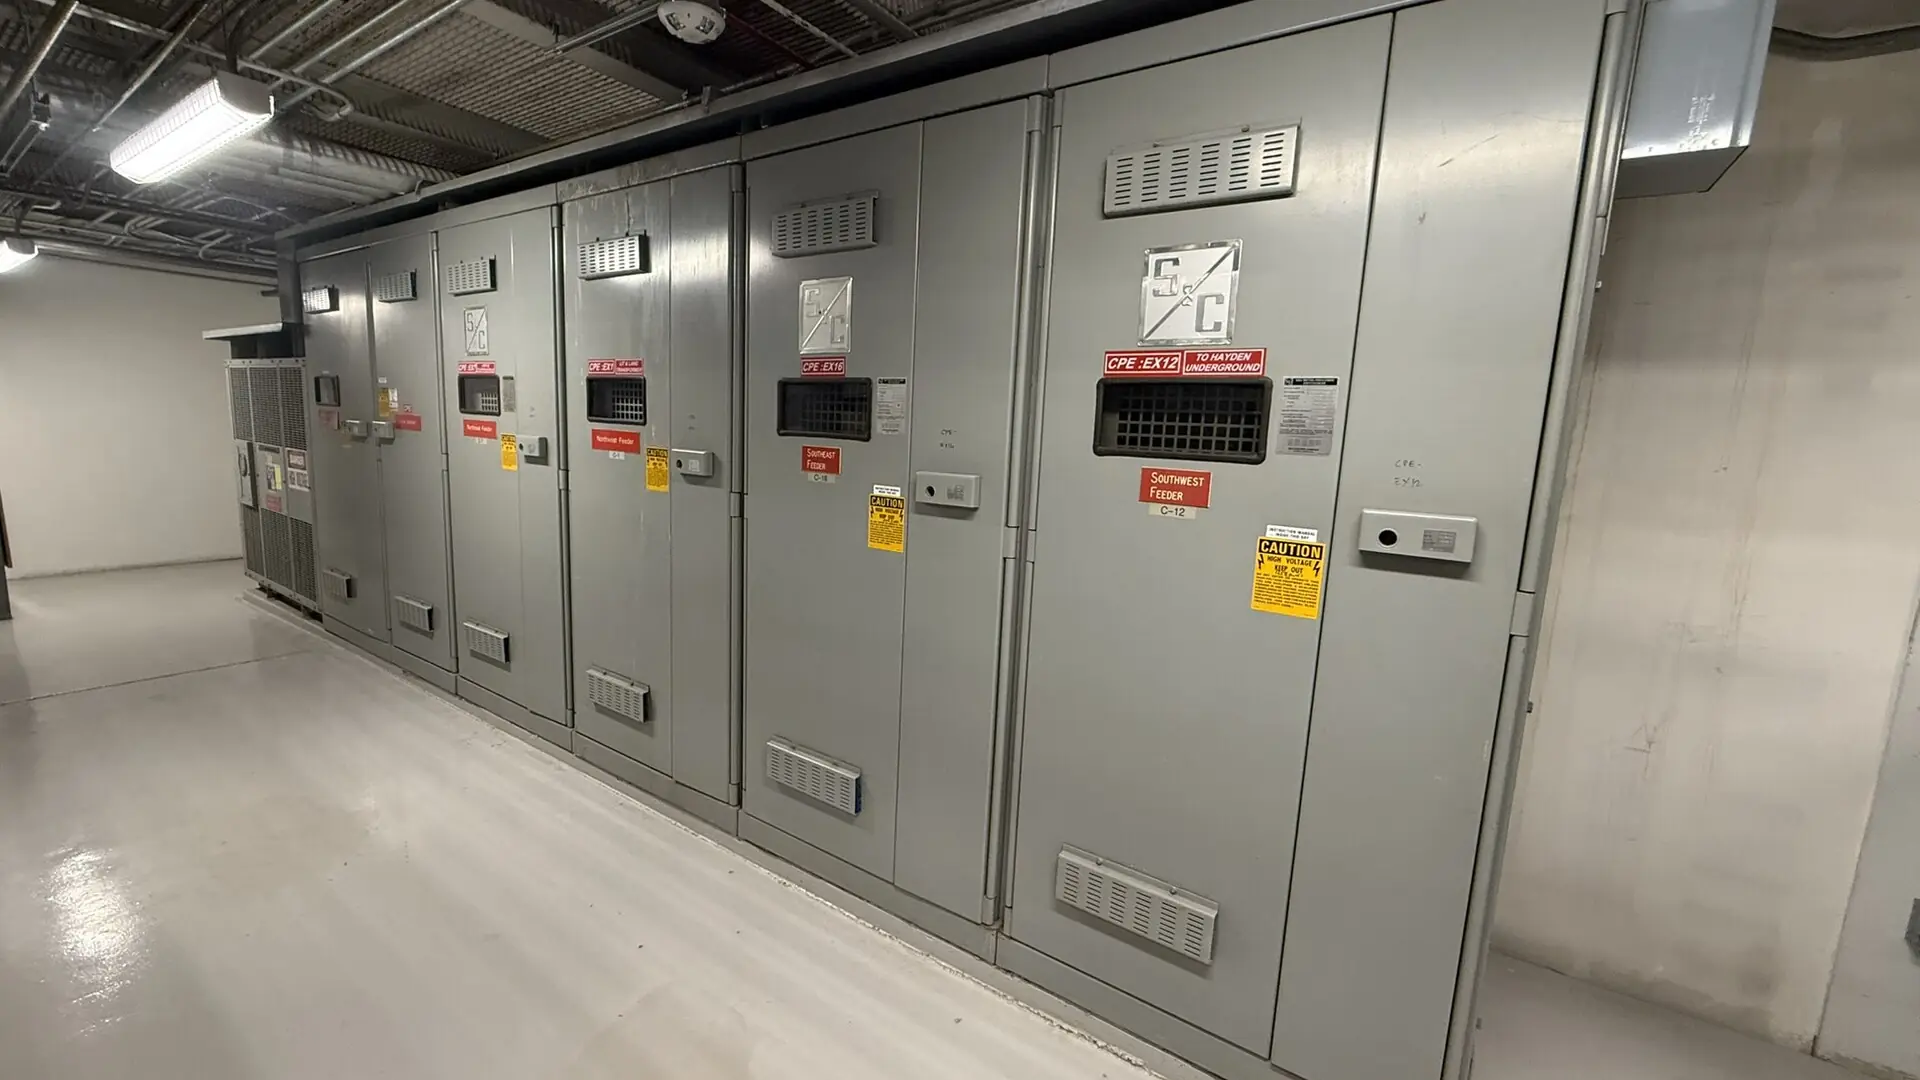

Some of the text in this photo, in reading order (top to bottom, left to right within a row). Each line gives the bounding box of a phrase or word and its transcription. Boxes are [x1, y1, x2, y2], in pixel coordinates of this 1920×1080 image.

[1196, 352, 1252, 361] TO HAYDEN
[1108, 357, 1137, 370] CPE
[1185, 363, 1261, 372] UNDERGROUND
[871, 496, 903, 509] CAUTION
[1160, 505, 1185, 517] C-12
[1261, 540, 1321, 558] CAUTION
[1267, 555, 1312, 567] HIGH VOLTAGE
[1291, 566, 1303, 574] OUT
